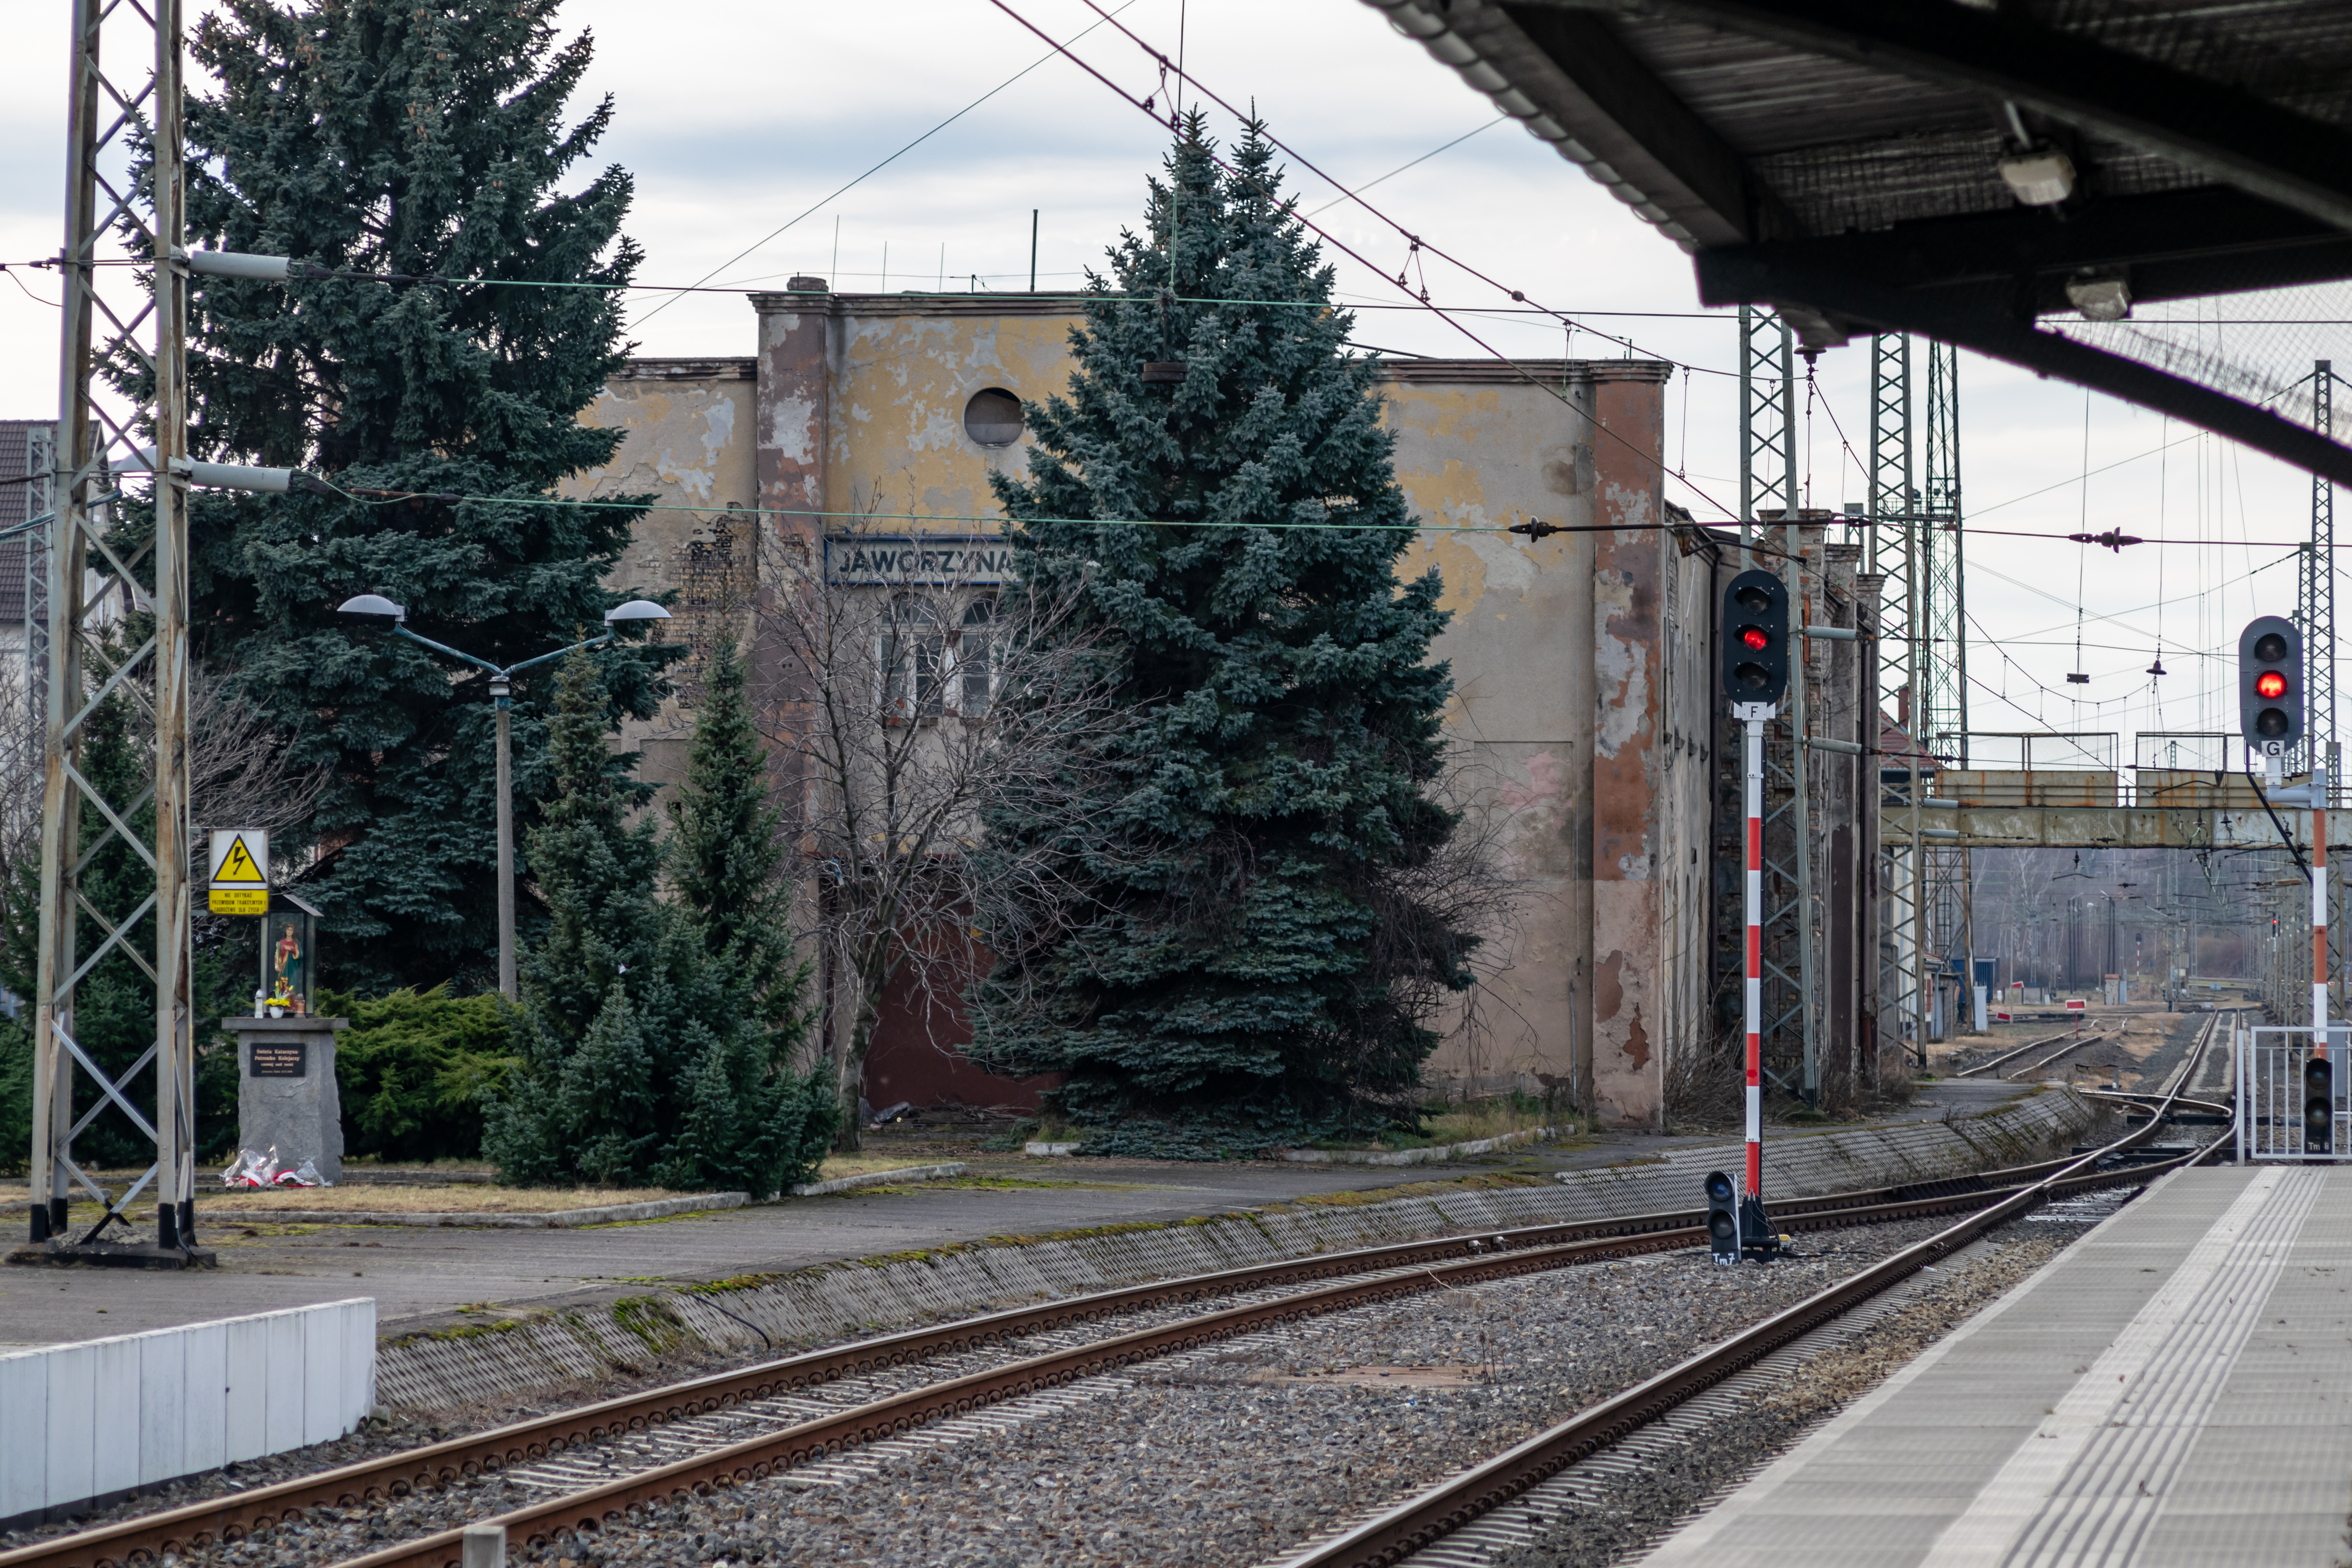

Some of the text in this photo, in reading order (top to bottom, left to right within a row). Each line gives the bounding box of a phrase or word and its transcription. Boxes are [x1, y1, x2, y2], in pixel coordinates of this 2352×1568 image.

[839, 550, 1013, 573] JAWORZYNA
[1751, 706, 1758, 718] F
[2267, 741, 2280, 756] G
[2308, 1141, 2329, 1151] Tm 8
